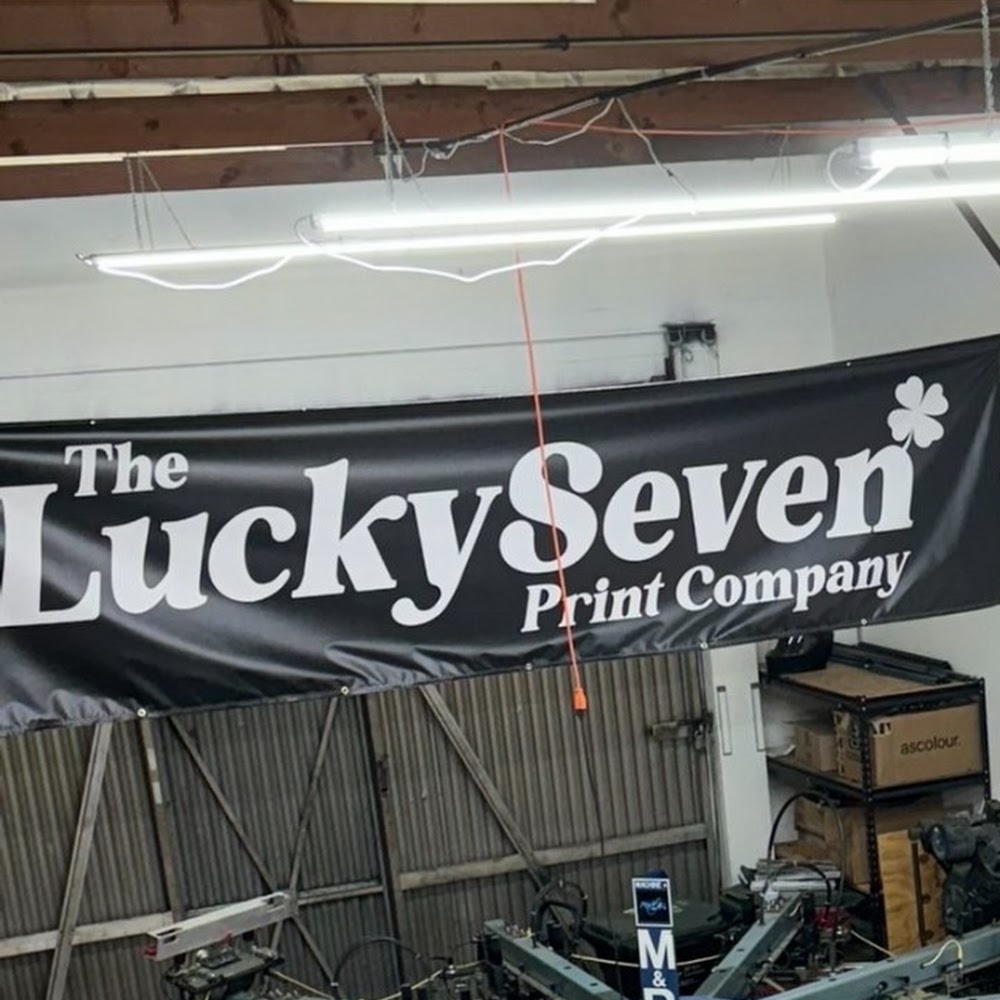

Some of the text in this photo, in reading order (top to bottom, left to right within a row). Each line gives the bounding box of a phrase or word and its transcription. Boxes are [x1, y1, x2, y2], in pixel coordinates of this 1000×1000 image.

[64, 441, 189, 497] The
[521, 551, 911, 633] Print Company
